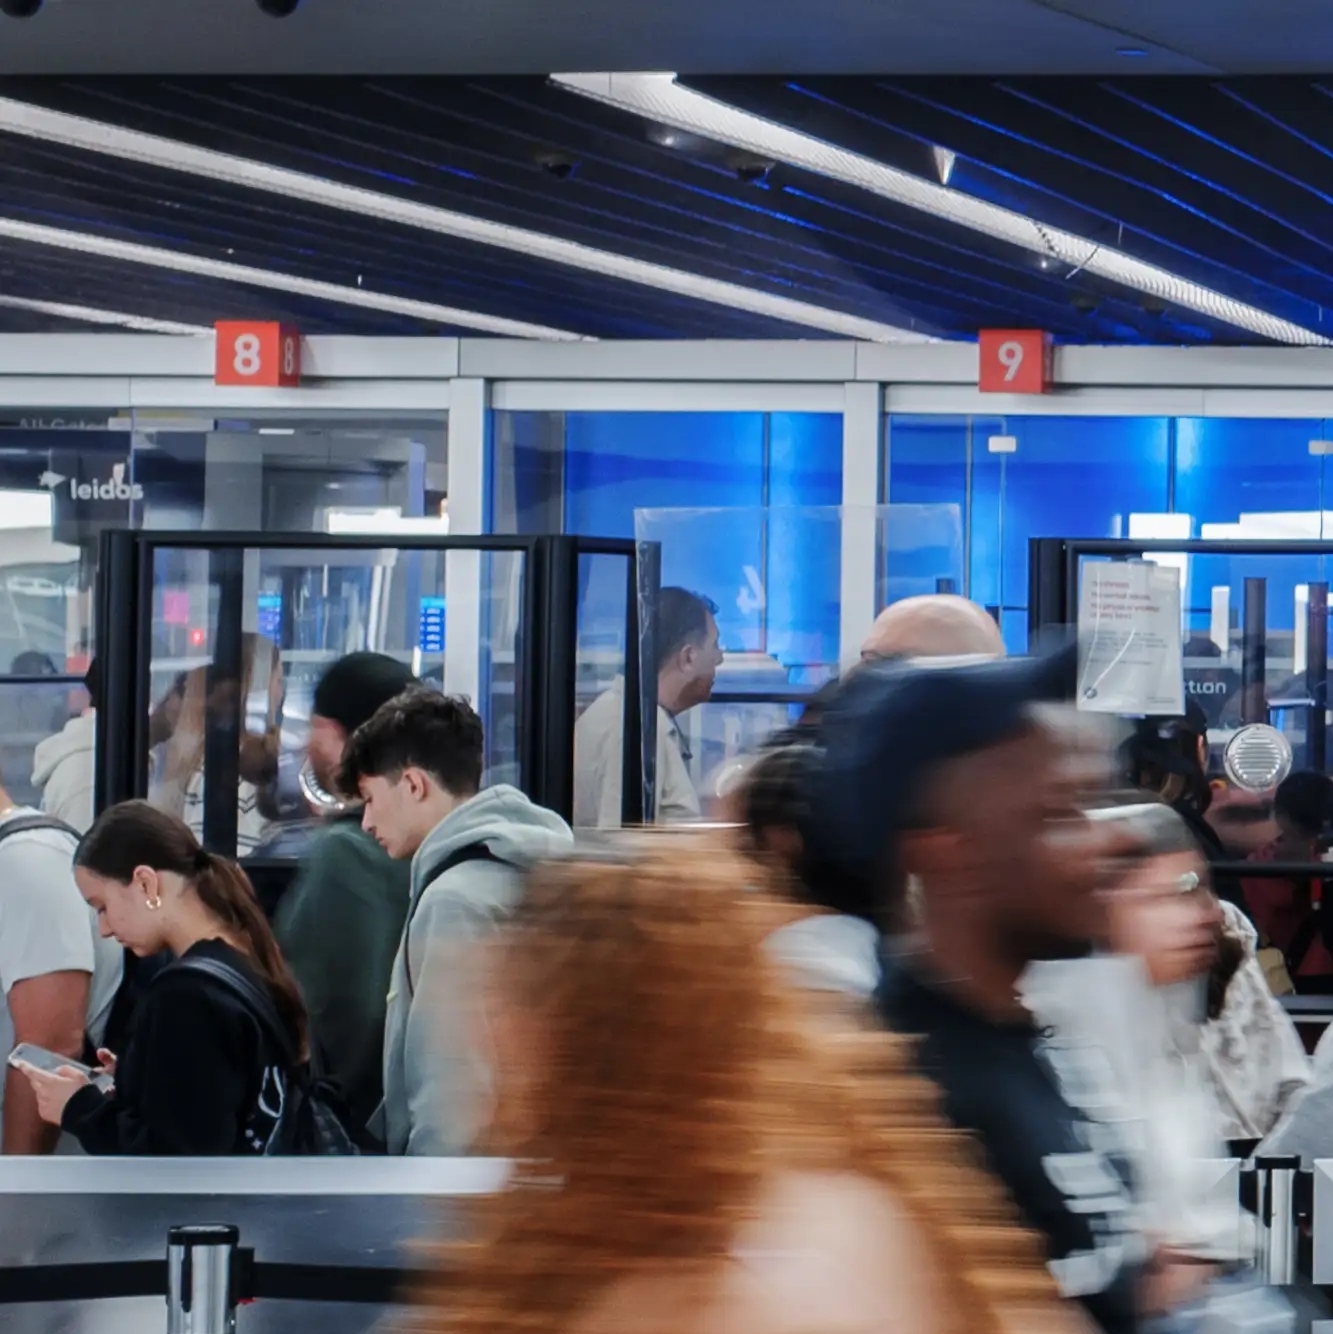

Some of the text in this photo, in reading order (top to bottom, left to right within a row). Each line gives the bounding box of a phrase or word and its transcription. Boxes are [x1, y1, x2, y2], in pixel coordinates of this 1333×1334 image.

[234, 333, 261, 376] 8
[998, 341, 1023, 381] 9
[70, 478, 143, 499] leidos
